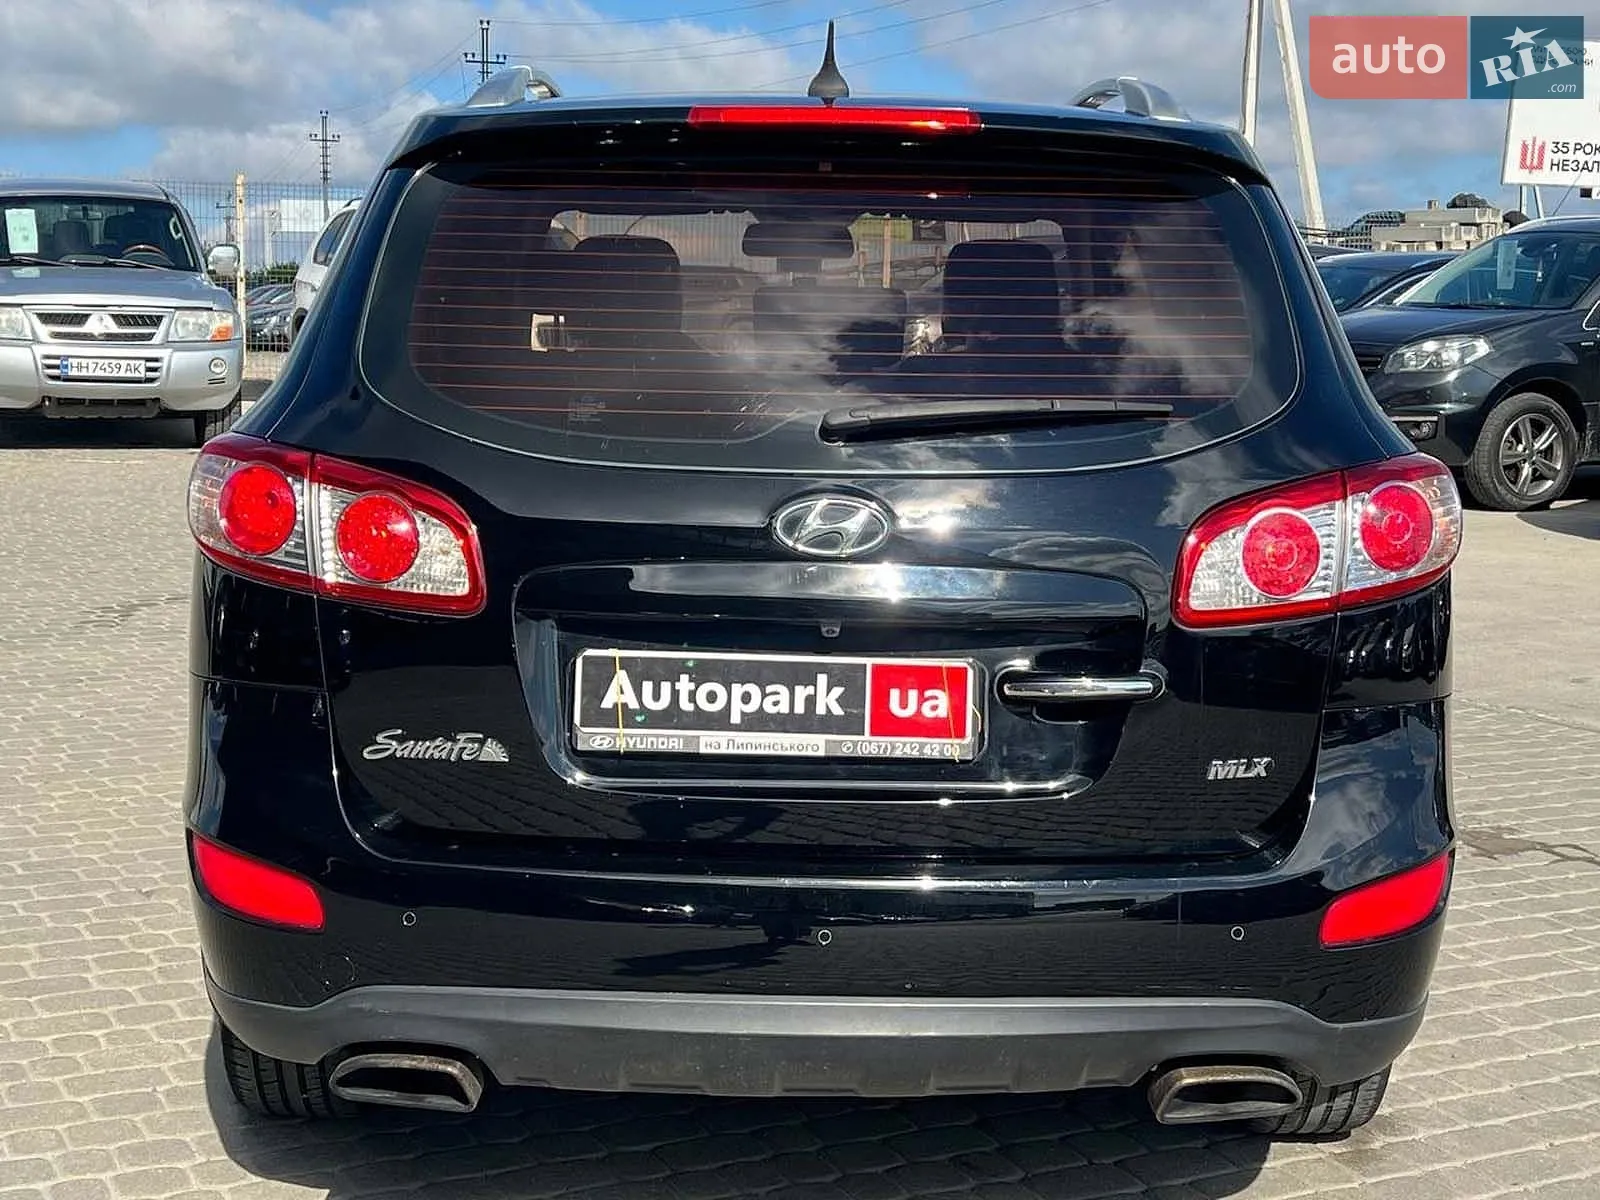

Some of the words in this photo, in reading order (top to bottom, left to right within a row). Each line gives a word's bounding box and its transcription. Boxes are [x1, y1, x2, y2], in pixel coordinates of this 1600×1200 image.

[1551, 141, 1570, 154] 35
[1550, 158, 1600, 173] НЕЗАЛ
[92, 361, 122, 375] 7459
[125, 362, 142, 375] AK
[600, 669, 845, 724] Autopark
[889, 687, 949, 718] ua
[704, 741, 721, 751] на
[726, 739, 820, 753] Липинського
[857, 741, 891, 756] (067)
[895, 743, 920, 756] 242
[923, 744, 940, 756] 42
[1207, 757, 1272, 780] MLX
